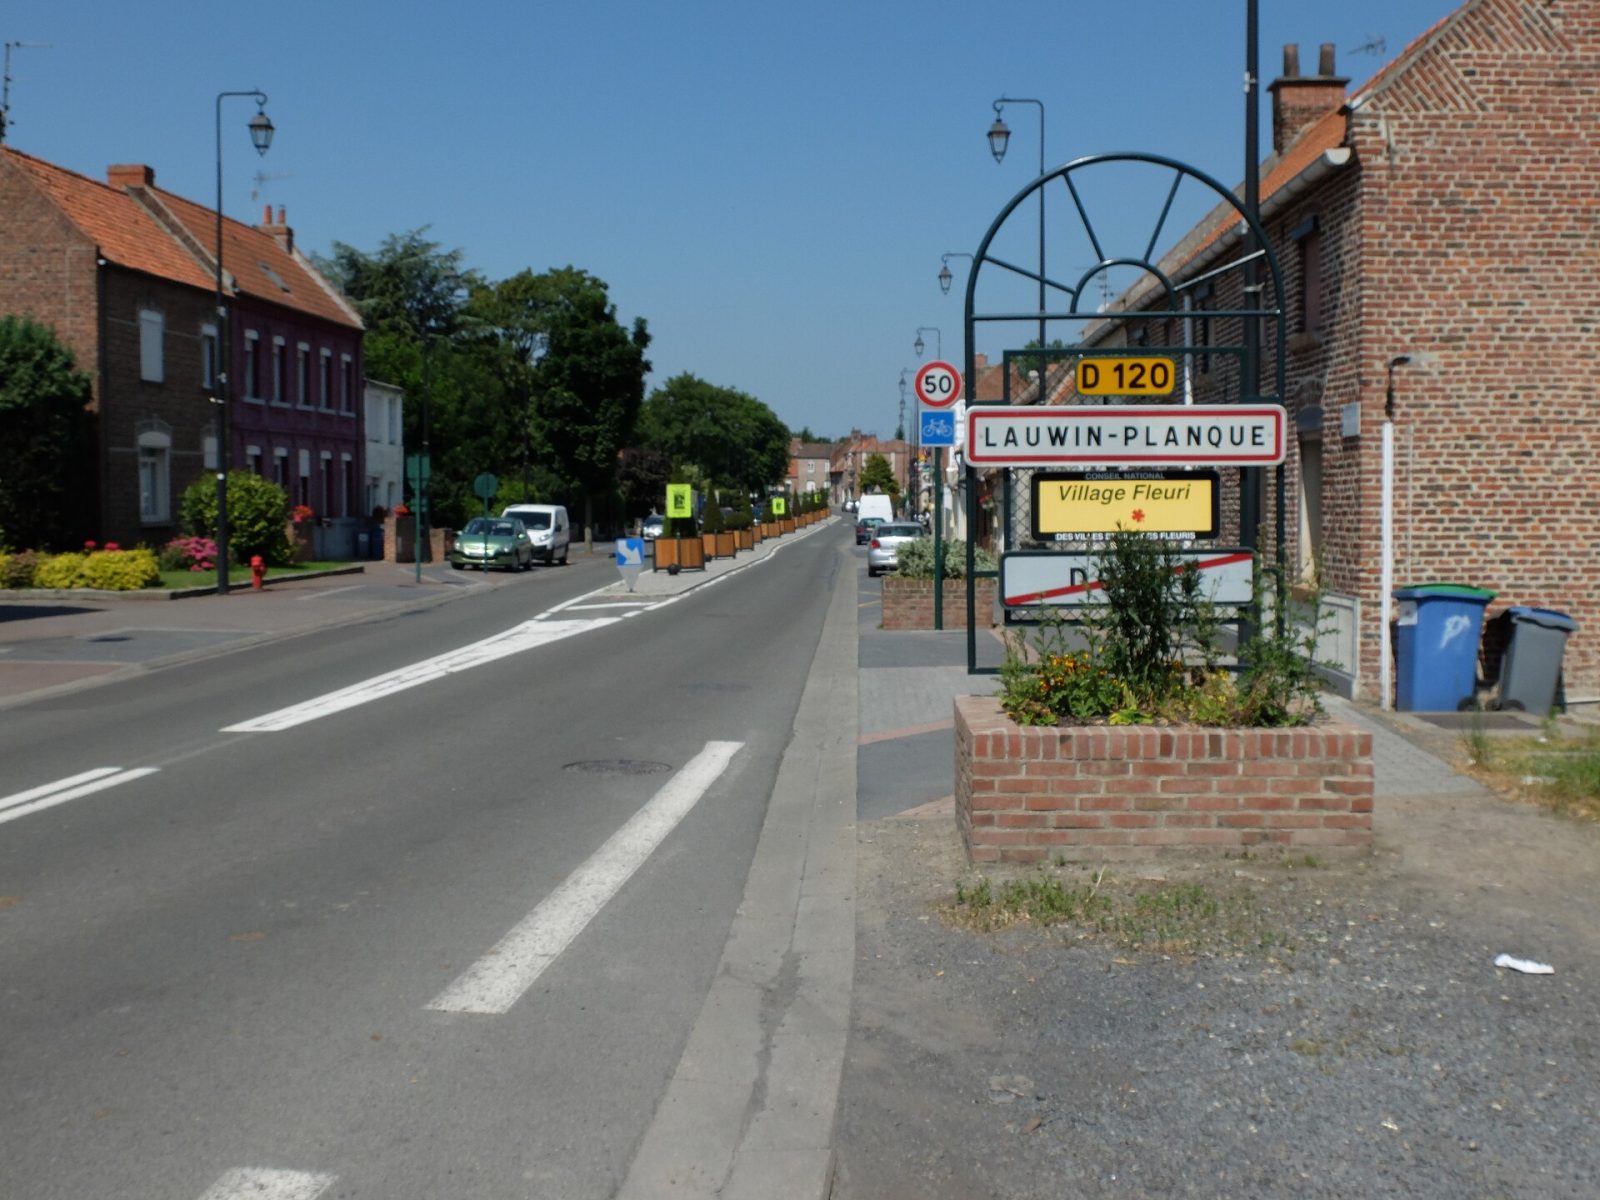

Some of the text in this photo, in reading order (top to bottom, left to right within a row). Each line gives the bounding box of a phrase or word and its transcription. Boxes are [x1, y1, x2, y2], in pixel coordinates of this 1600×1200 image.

[924, 374, 952, 394] 50
[1081, 362, 1170, 389] D 120
[984, 425, 1265, 448] LAUWIN-PLANQUE
[1085, 472, 1166, 480] CONSEIL NATIONAL
[1059, 483, 1192, 505] Village Fleuri
[1055, 532, 1074, 541] DES
[1160, 532, 1196, 540] FLEURIS
